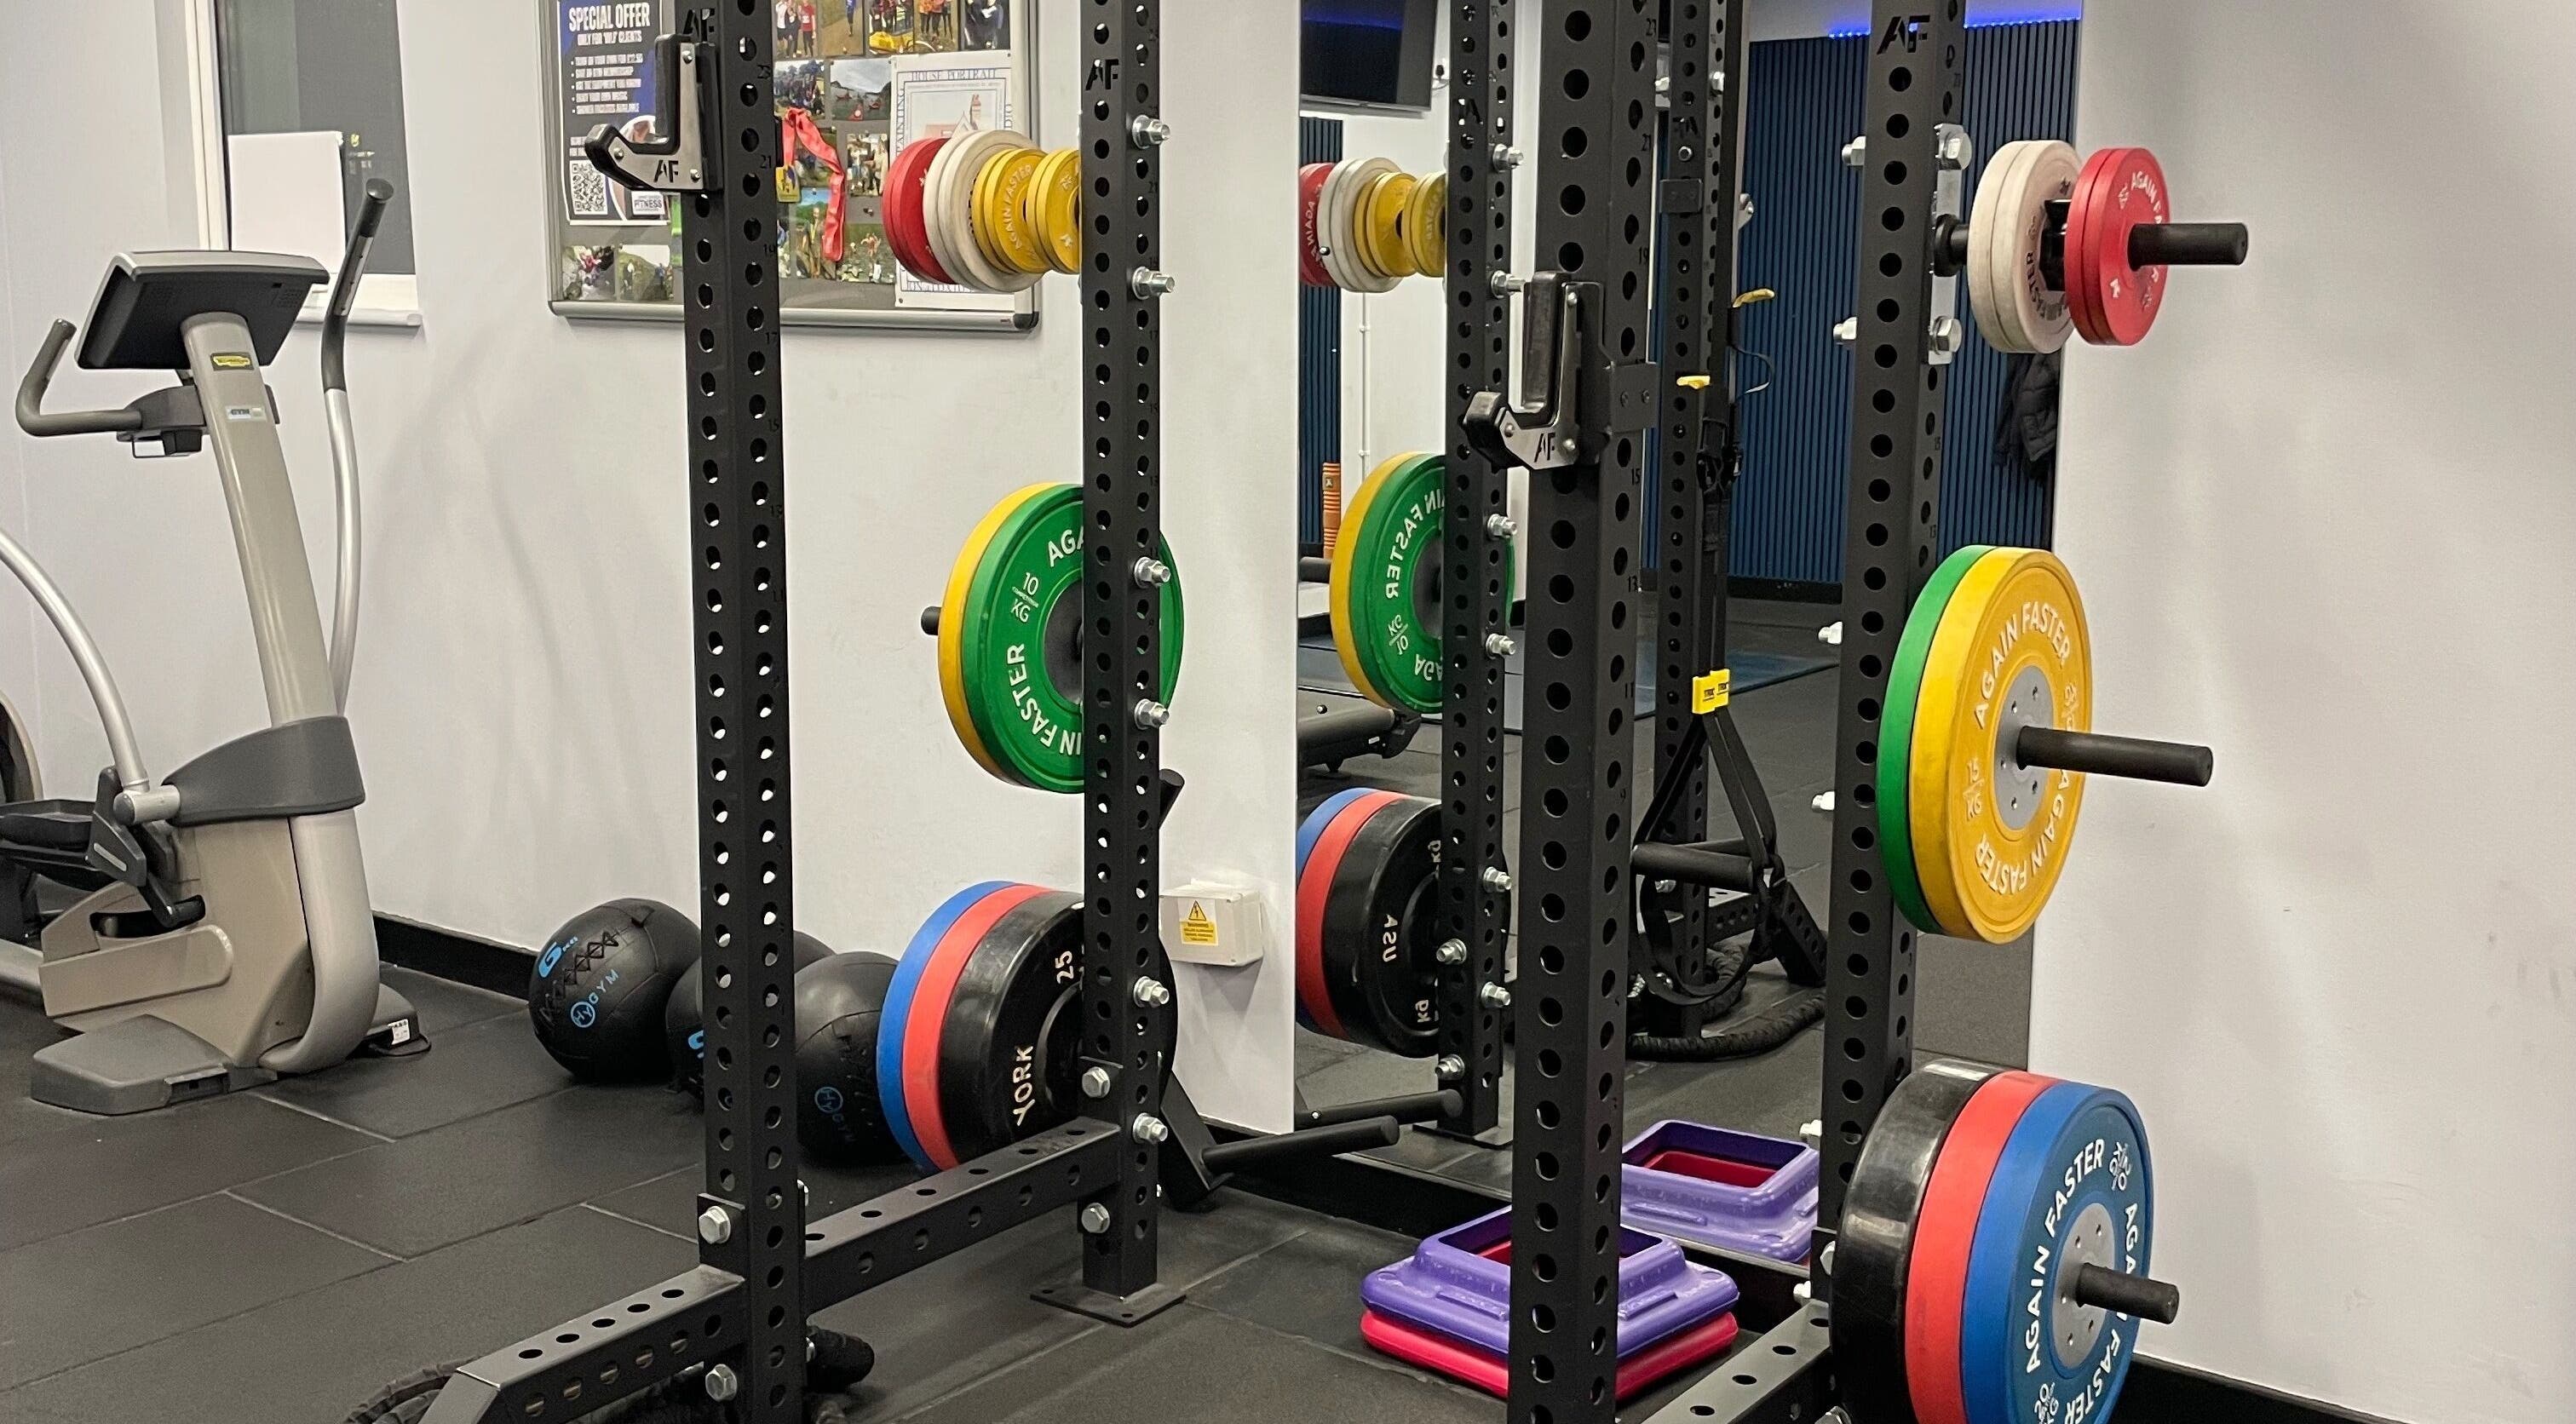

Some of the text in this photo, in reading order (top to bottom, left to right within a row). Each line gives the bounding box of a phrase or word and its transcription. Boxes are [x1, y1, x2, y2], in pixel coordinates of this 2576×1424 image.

[568, 3, 650, 32] SPECIAL OFFER
[1877, 15, 1930, 55] AF
[1085, 59, 1119, 91] AF
[653, 159, 679, 183] AF
[2131, 171, 2157, 204] AGAIN
[1534, 432, 1556, 462] AF
[1048, 525, 1084, 567] AGA
[1022, 572, 1039, 595] 10
[1011, 598, 1031, 623] KG
[1975, 601, 2070, 730] AGAIN FASTER
[1007, 643, 1057, 748] FASTER
[1975, 770, 2069, 895] AGAIN FASTER
[1055, 950, 1074, 984] 25
[589, 969, 619, 1004] GYM
[1013, 1046, 1035, 1126] YORK
[2026, 1139, 2104, 1374] AGAIN FASTER
[2064, 1329, 2120, 1424] FASTER
